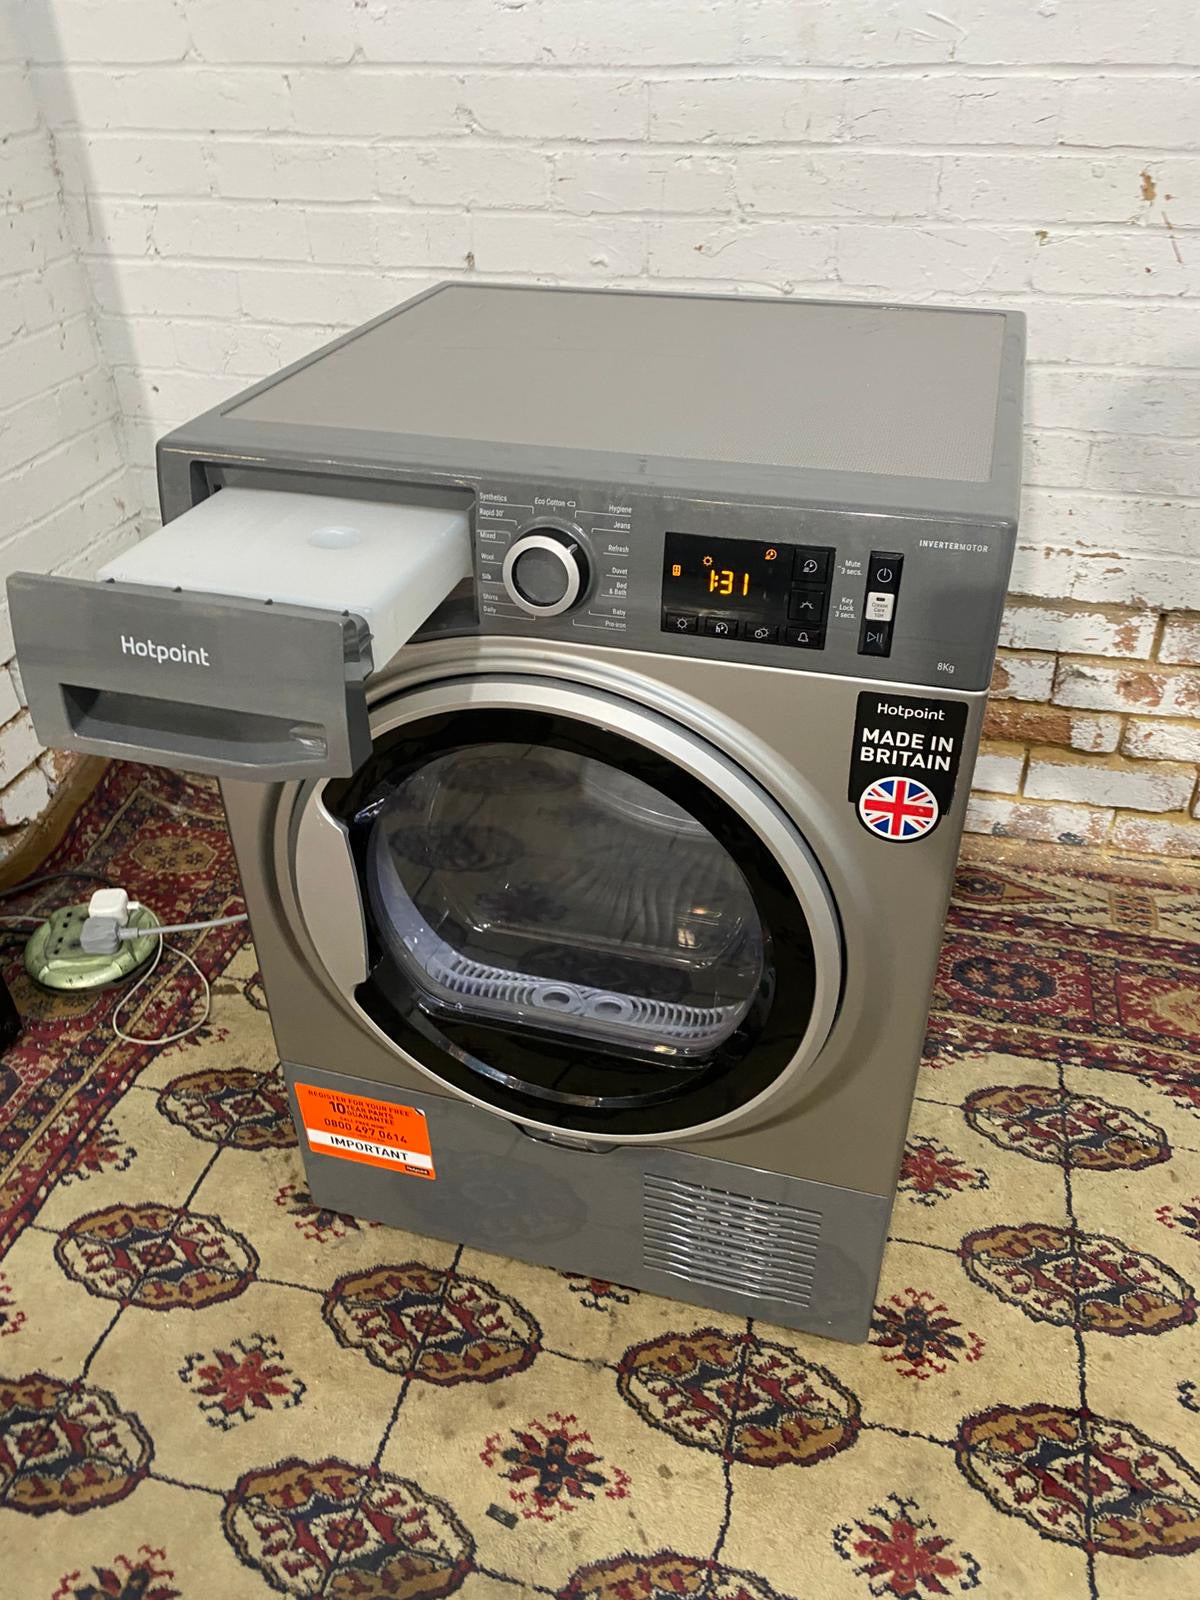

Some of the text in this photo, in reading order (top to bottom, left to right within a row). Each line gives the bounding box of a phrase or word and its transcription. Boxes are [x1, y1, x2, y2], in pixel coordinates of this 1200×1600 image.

[480, 492, 507, 502] Synthetics
[534, 497, 566, 507] Eco Cotton
[480, 508, 494, 517] Rapid
[608, 505, 632, 514] Hygiene
[613, 521, 630, 529] Jeans
[480, 531, 496, 539] Mixed
[608, 545, 629, 553] Refresh
[919, 539, 989, 552] INVERTERMOTOR
[845, 560, 861, 568] Mute
[612, 567, 628, 575] Duvet
[846, 568, 863, 576] secs.
[709, 569, 749, 596] 1:31
[483, 593, 498, 601] Shirts
[614, 588, 627, 596] Bath
[483, 606, 497, 614] Daily
[613, 608, 626, 616] Baby
[121, 635, 210, 667] Hotpoint
[937, 662, 955, 674] 8Kg
[877, 702, 946, 721] Hotpoint
[862, 727, 954, 753] MADE IN
[860, 746, 951, 772] BRITAIN
[308, 1089, 347, 1102] REGISTER
[348, 1098, 365, 1107] FOR
[365, 1102, 387, 1112] YOUR
[329, 1101, 394, 1120] 10 YEAR PARTS
[347, 1110, 394, 1125] GUARANTEE
[324, 1118, 352, 1131] 0800
[355, 1125, 376, 1138] 497
[378, 1130, 407, 1144] 0614
[330, 1136, 409, 1161] IMPORTANT
